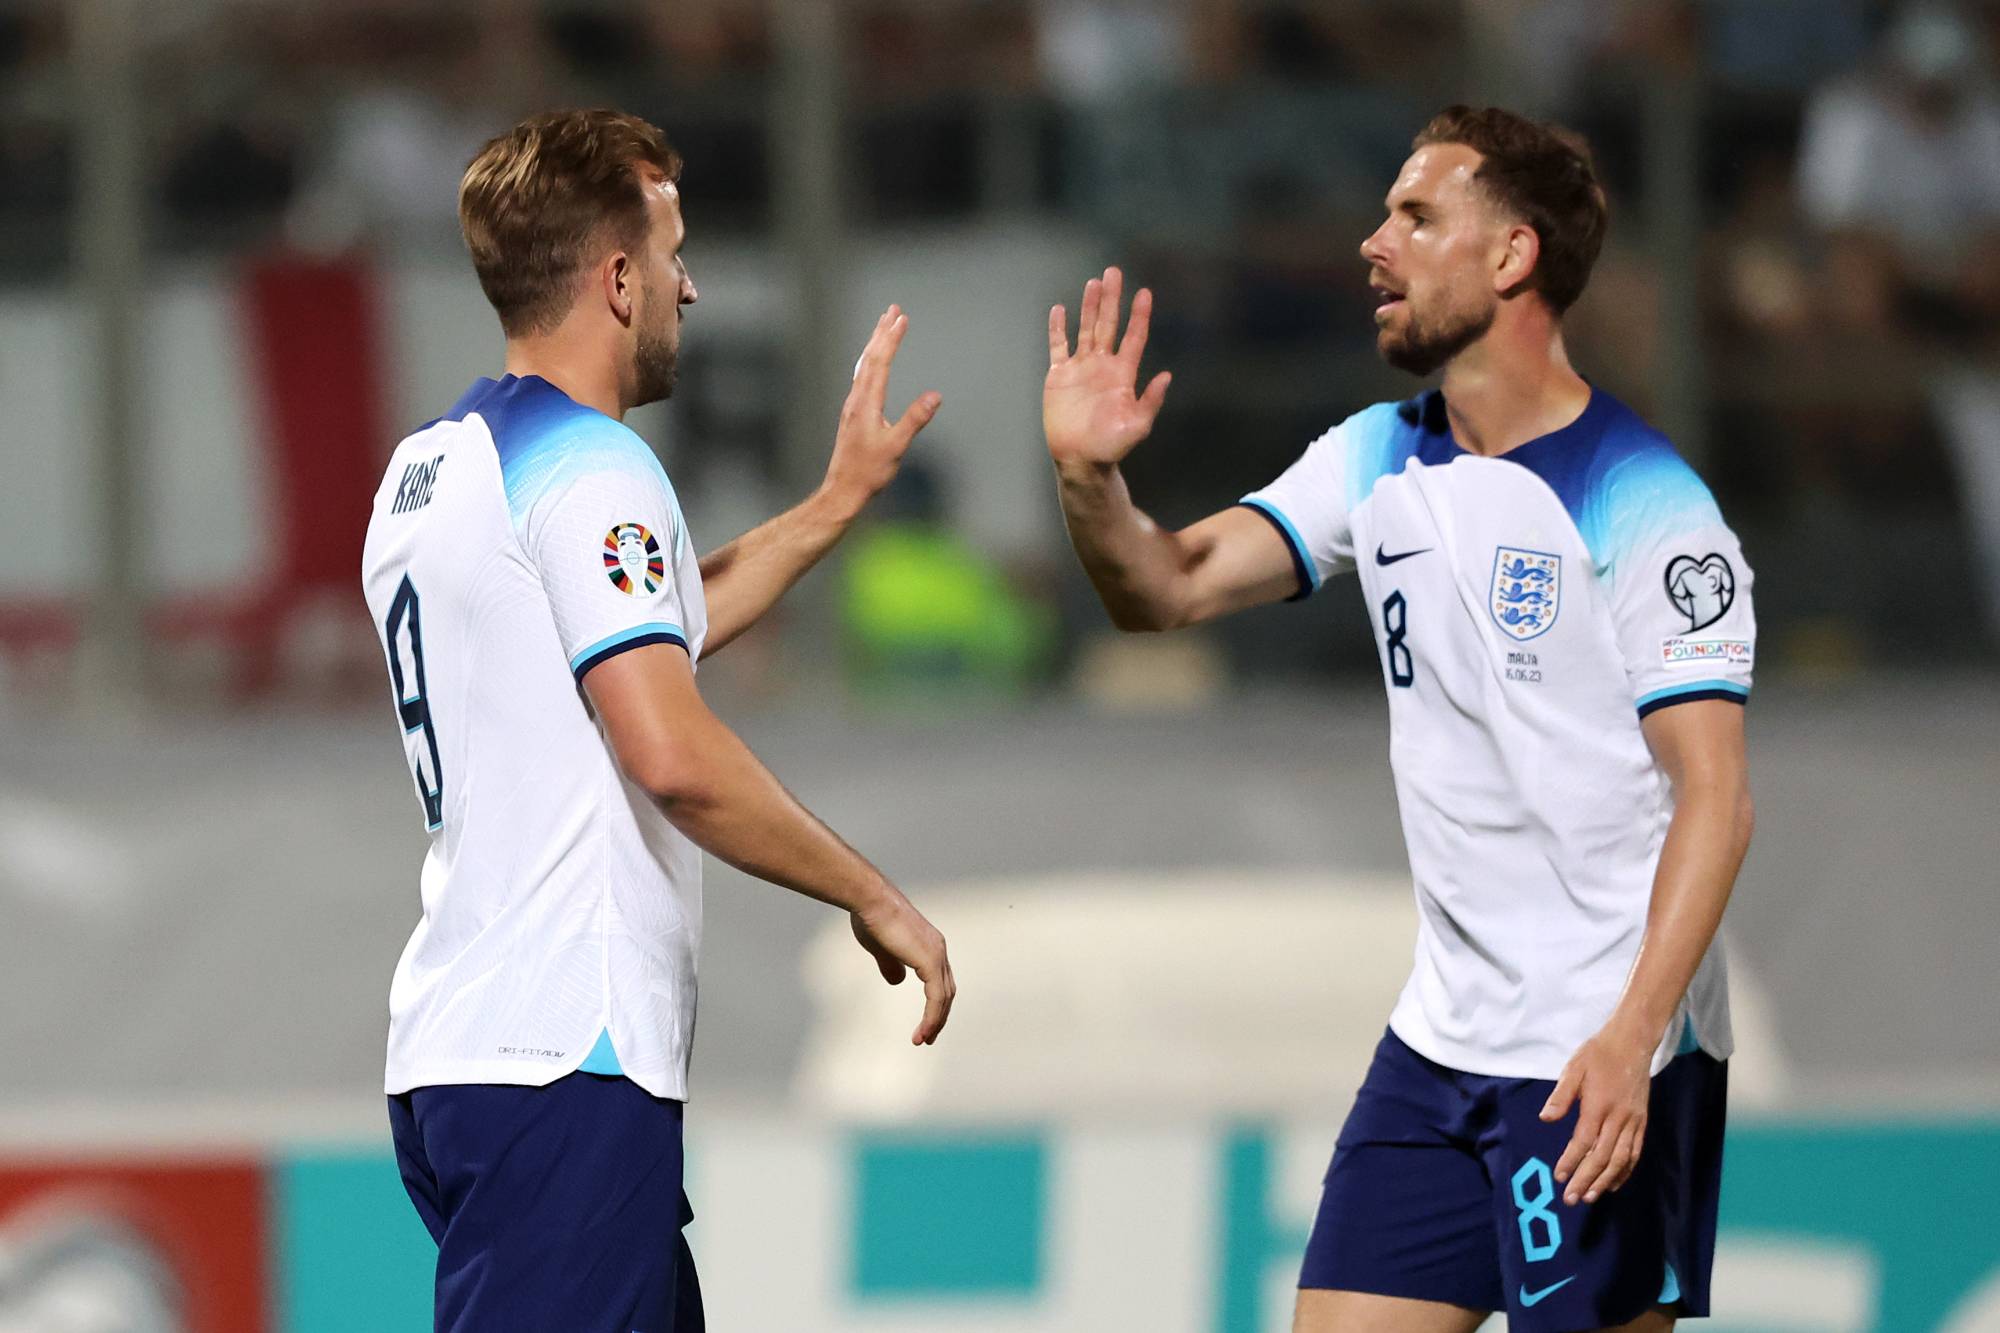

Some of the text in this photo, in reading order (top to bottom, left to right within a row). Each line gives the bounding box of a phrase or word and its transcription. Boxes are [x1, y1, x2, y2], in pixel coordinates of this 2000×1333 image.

[391, 454, 446, 515] KANE
[1383, 589, 1414, 688] 8
[1507, 652, 1538, 666] MALTA
[1663, 643, 1751, 659] FOUNDATION
[385, 570, 444, 831] 9
[1511, 1156, 1563, 1263] 8
